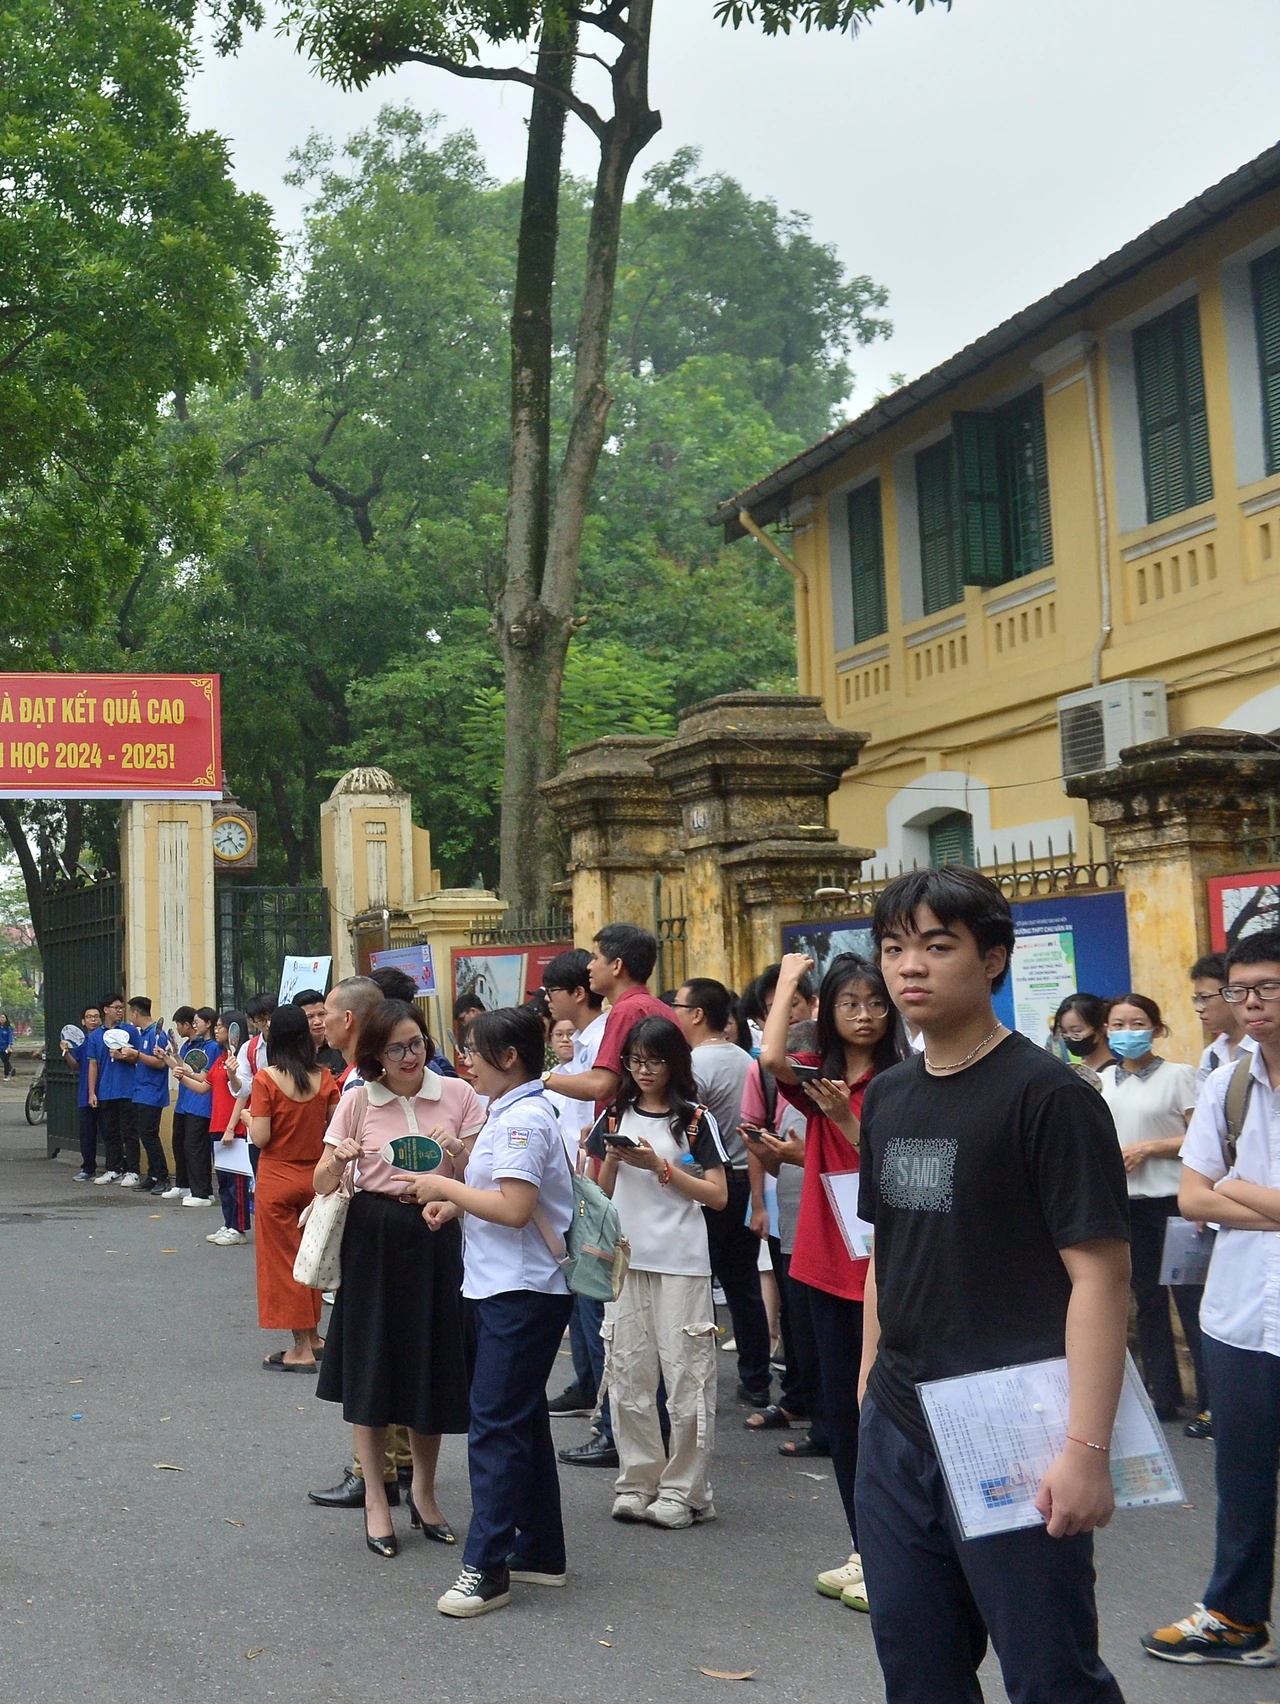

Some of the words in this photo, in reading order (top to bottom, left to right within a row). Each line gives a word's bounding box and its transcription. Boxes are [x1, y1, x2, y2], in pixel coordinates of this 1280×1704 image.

[19, 697, 57, 729] ĐẠT
[62, 690, 97, 724] KẾT
[102, 690, 142, 727] QUẢ
[147, 698, 185, 724] CAO
[10, 741, 50, 773] HỌC
[55, 743, 102, 769] 2024
[121, 743, 175, 769] 2025!
[897, 1156, 940, 1188] SAND
